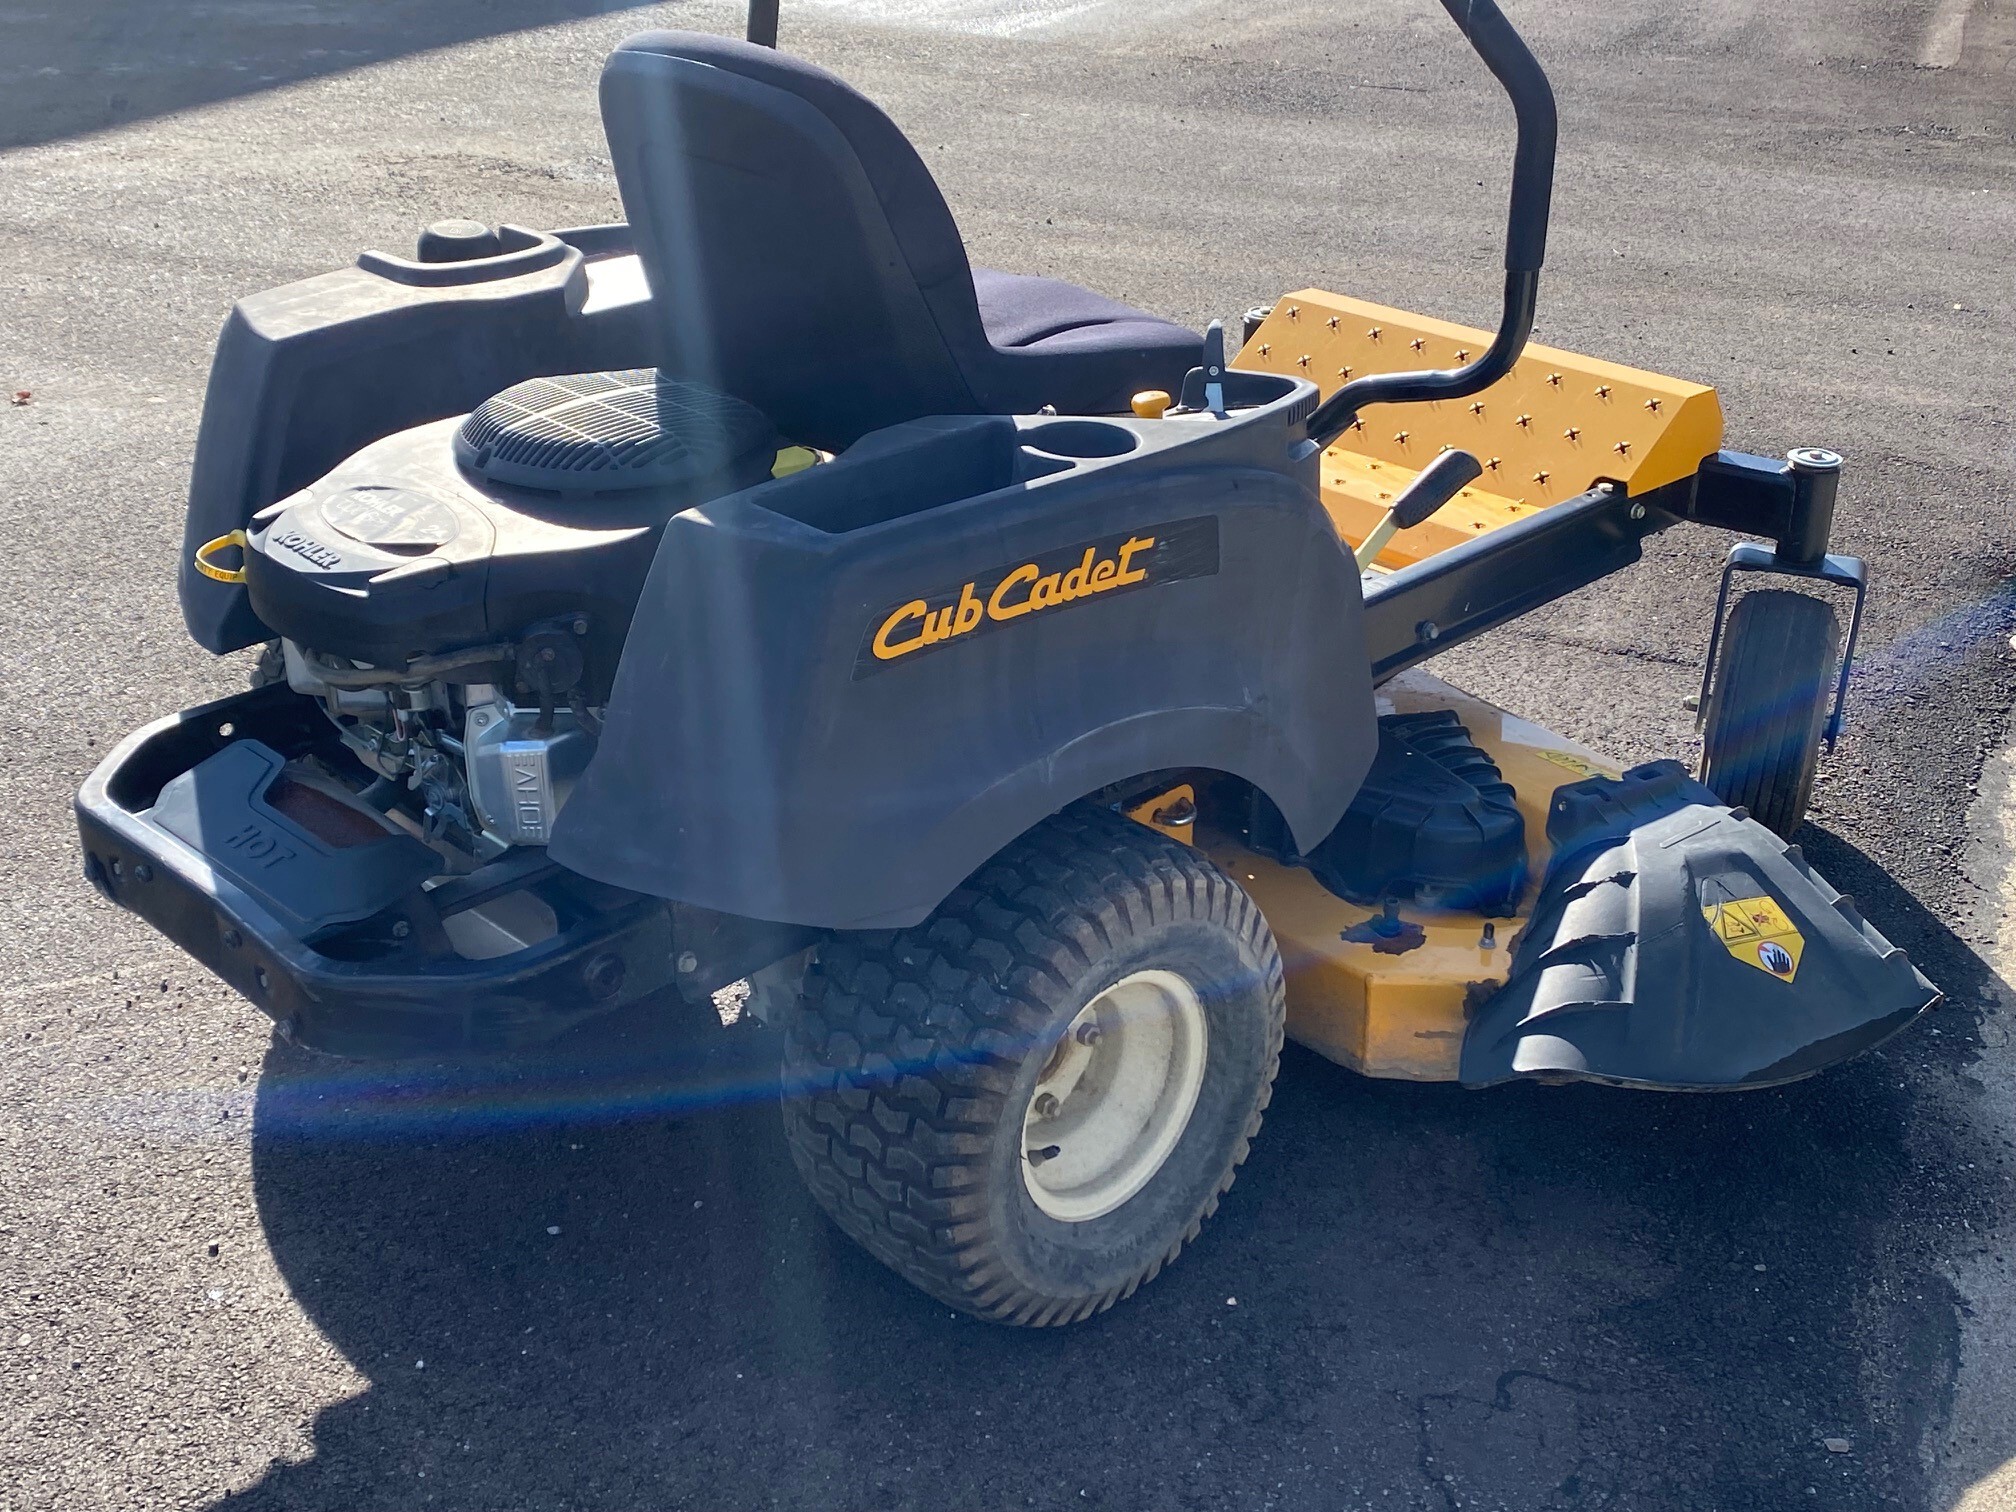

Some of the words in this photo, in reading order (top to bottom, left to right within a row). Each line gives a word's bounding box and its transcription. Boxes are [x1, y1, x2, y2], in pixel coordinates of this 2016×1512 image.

[272, 530, 342, 570] KOHLER
[872, 582, 983, 660] Cub
[987, 537, 1155, 621] Cadet
[222, 824, 297, 869] HOT
